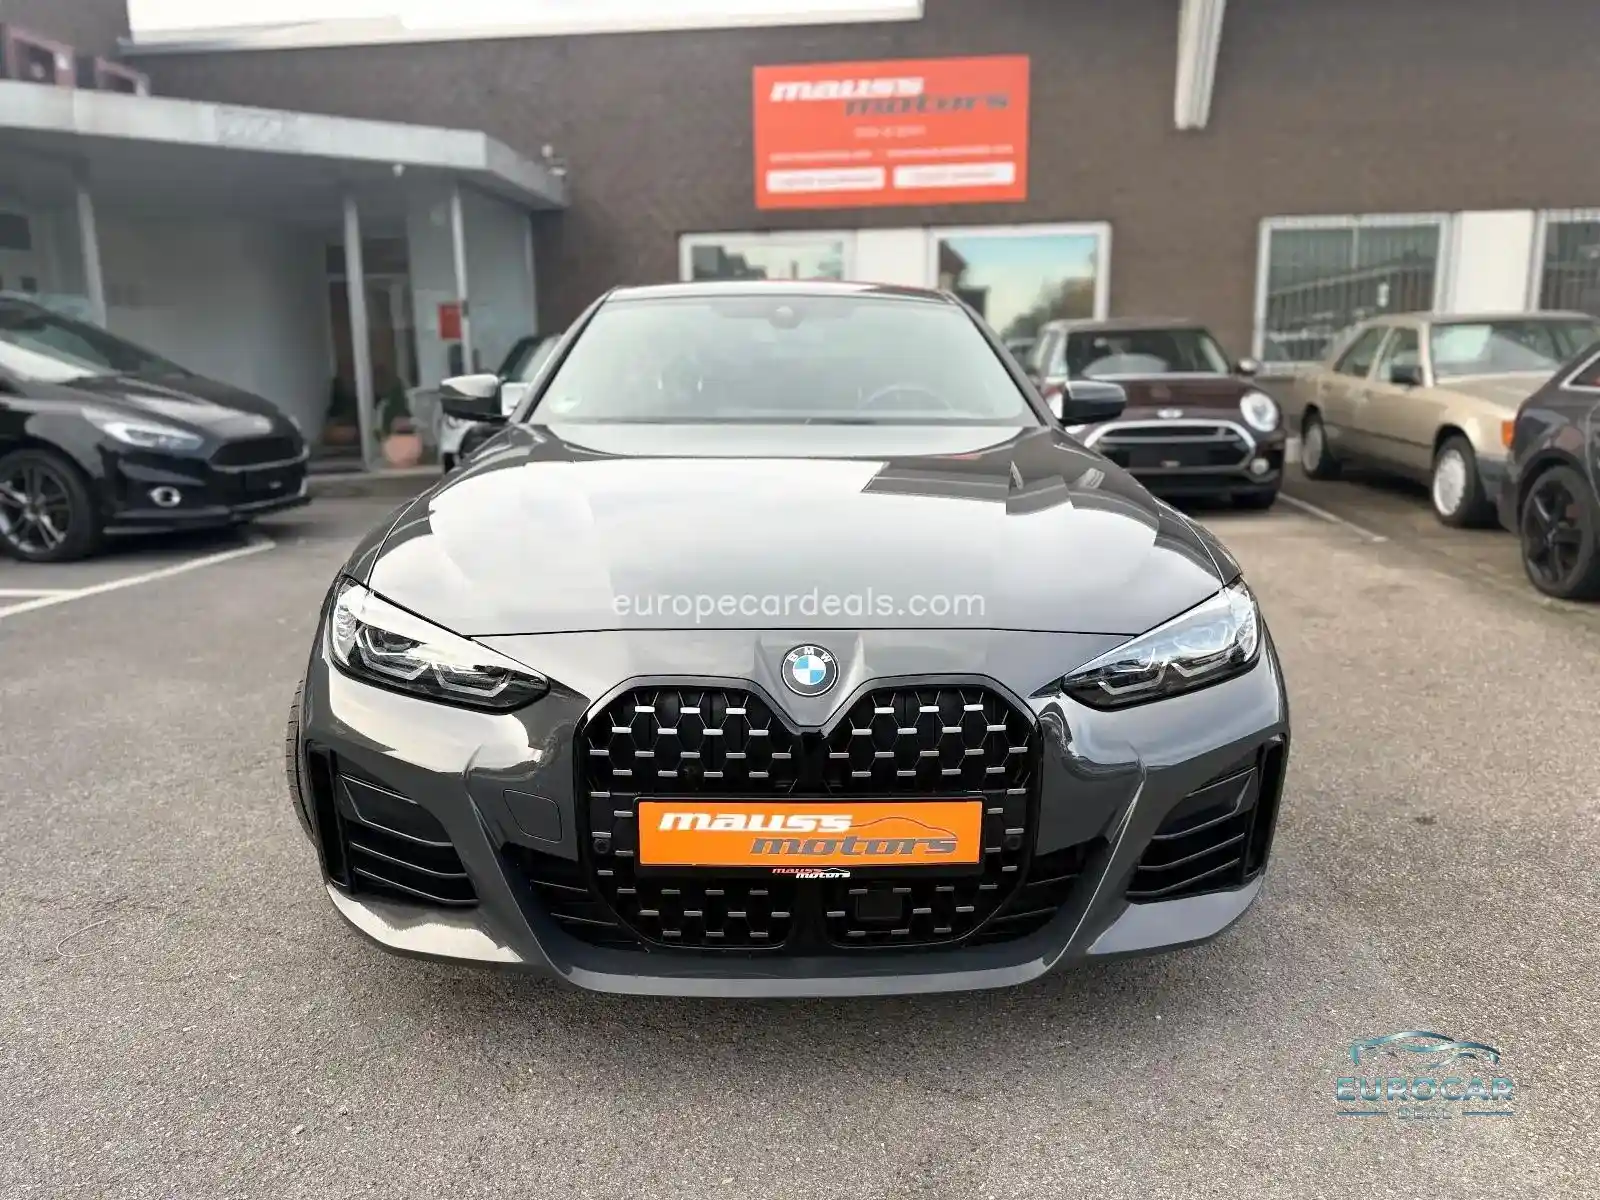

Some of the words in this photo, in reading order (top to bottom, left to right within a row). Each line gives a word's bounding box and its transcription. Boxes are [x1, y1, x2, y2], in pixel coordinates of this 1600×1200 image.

[770, 77, 924, 102] mauss
[845, 92, 1010, 117] motors
[787, 646, 832, 662] BMW
[659, 812, 853, 832] mauss
[750, 836, 958, 856] motors
